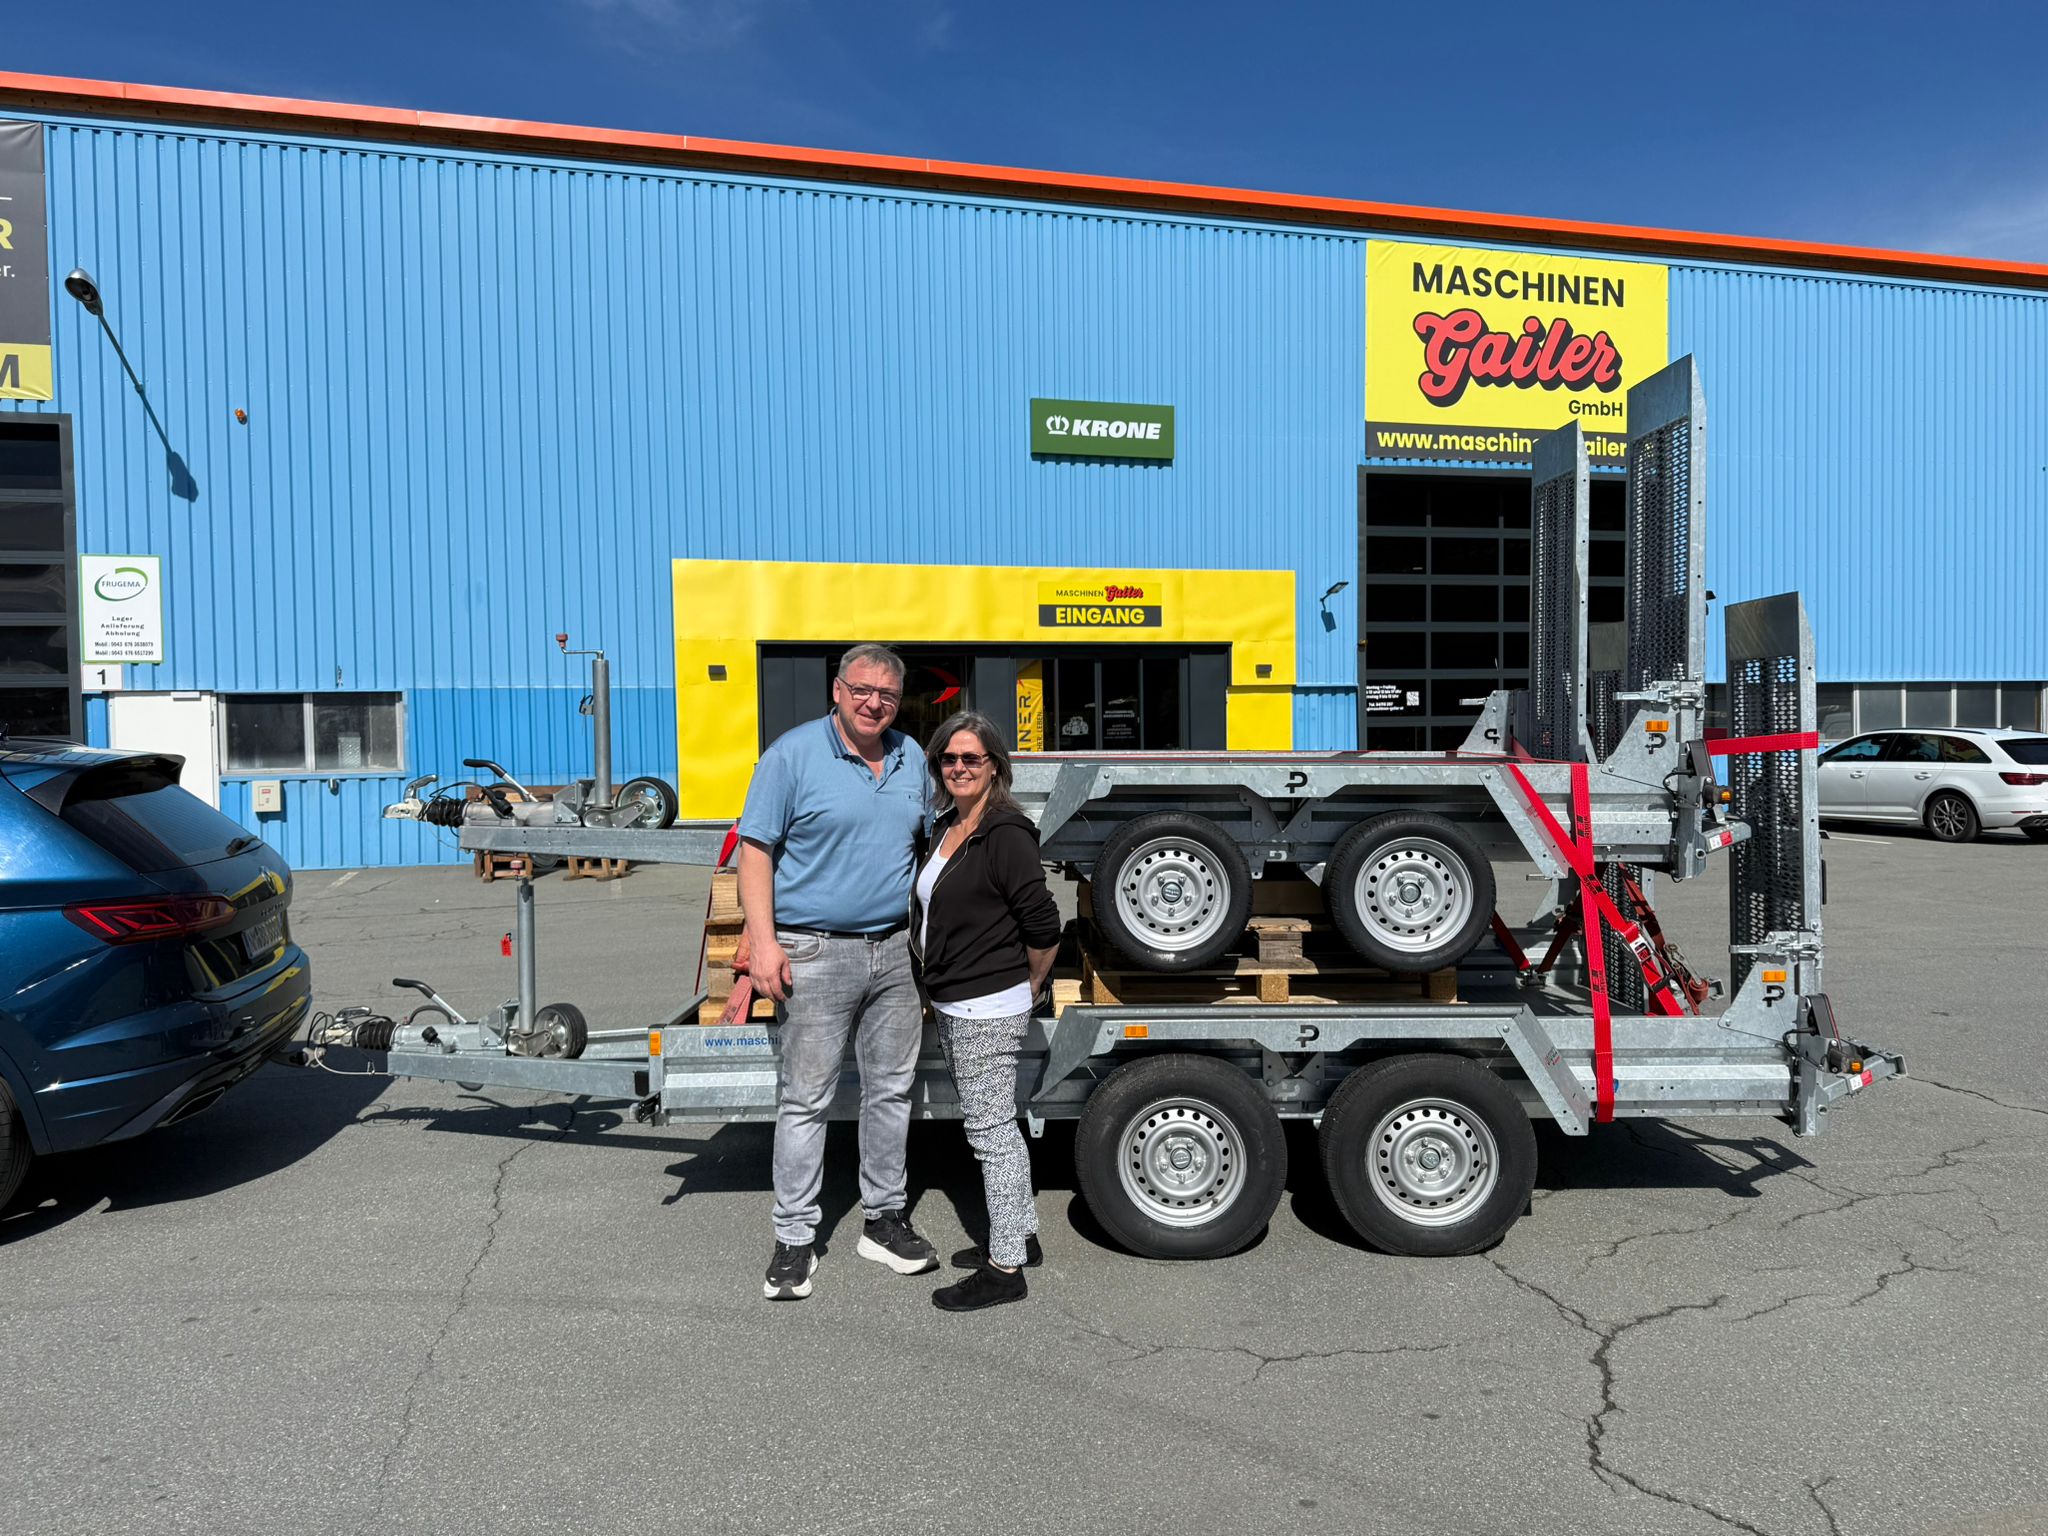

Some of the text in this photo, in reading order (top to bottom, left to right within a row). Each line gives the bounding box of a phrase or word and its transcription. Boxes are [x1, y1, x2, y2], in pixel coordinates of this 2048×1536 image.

[1412, 262, 1625, 307] MASCHINEN
[1413, 308, 1623, 407] Gailer
[1568, 400, 1623, 417] GmbH
[1071, 418, 1162, 440] KRONE
[101, 580, 141, 588] FRUGEMA
[1055, 585, 1144, 602] MASCHINEN Gailer
[1055, 607, 1145, 625] EINGANG
[96, 669, 107, 685] 1
[704, 1033, 781, 1048] www.maschi
